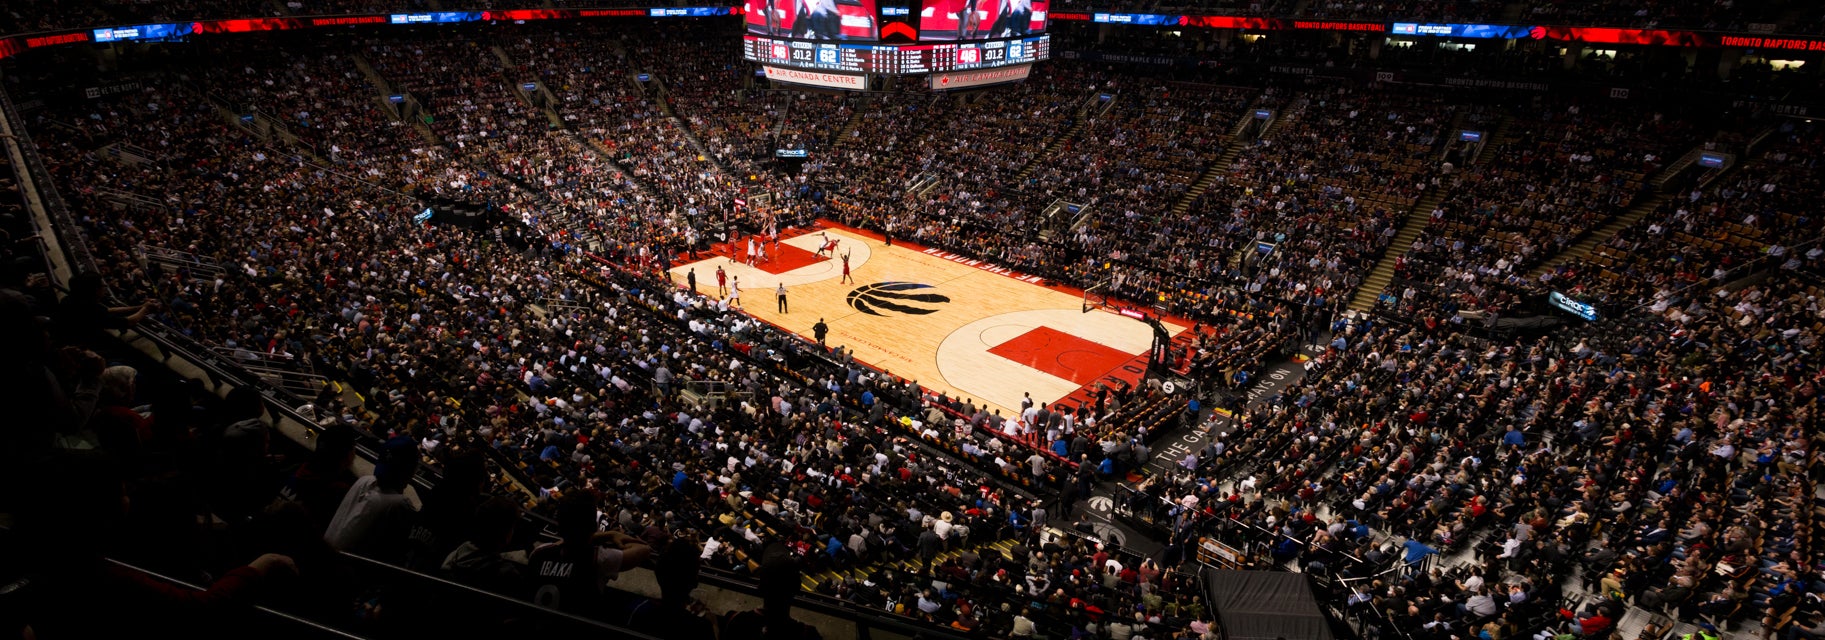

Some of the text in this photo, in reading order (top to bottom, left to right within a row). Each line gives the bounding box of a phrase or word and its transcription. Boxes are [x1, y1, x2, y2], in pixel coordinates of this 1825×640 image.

[1321, 22, 1347, 30] RAPTORS
[1348, 23, 1385, 32] BASKETBALL
[1721, 36, 1762, 47] TORONTO
[1764, 39, 1807, 50] RAPTORS
[820, 49, 836, 62] 62
[960, 50, 976, 63] 46
[1010, 46, 1021, 57] 62
[789, 71, 819, 81] CANADA
[823, 75, 856, 84] CENTRE
[954, 74, 968, 83] AIR
[973, 71, 1001, 81] CANADA
[1770, 104, 1807, 115] NORTH
[923, 248, 981, 266] NORTH
[979, 263, 1012, 276] THE
[1270, 368, 1291, 380] ON
[1155, 442, 1189, 461] THE
[540, 561, 574, 578] IBAKA
